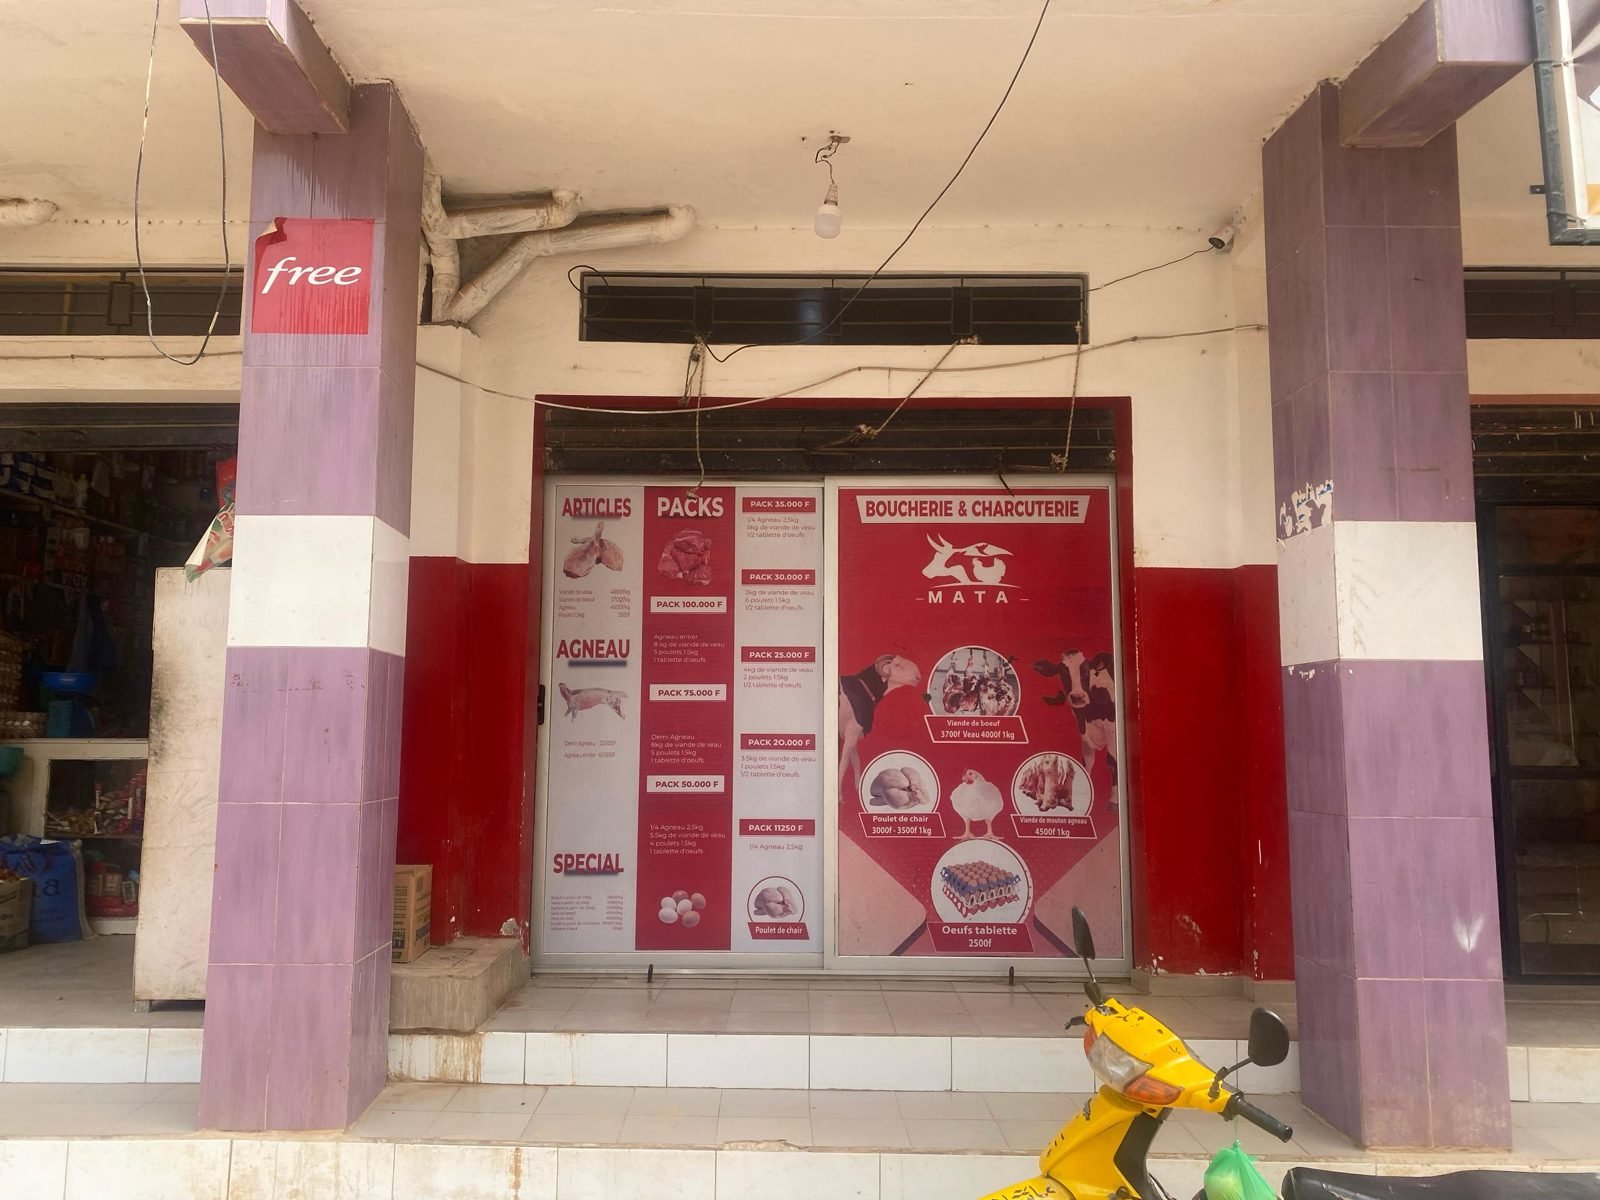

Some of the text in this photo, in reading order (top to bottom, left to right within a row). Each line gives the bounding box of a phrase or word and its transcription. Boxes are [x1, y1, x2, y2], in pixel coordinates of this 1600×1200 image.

[261, 255, 363, 295] free
[561, 497, 632, 518] ARTICLES
[656, 496, 725, 518] PACKS
[750, 500, 810, 508] PACK 35.000 F
[865, 500, 1080, 518] BOUCHERIE & CHARCUTERIE
[749, 573, 811, 581] PACK 30.000 F
[927, 590, 1009, 604] MATA
[555, 638, 631, 659] AGNEAU
[749, 651, 810, 659] PACK 25.000 F
[658, 689, 721, 697] PACK 75.000 F
[946, 719, 1001, 727] Viande de boeuf
[669, 734, 695, 742] Agneau
[940, 730, 1015, 741] 3700f Veau 4000f 1kg
[805, 739, 811, 747] F
[872, 815, 929, 823] Poulet de chair
[1020, 816, 1038, 824] Viande
[1067, 818, 1088, 826] agneau
[748, 824, 804, 832] PACK 11250 F
[871, 826, 932, 836] 3000f 3500f 1kg
[1034, 828, 1070, 838] 4500f 1kg
[552, 852, 625, 874] SPECIAL
[755, 926, 803, 934] Poulet de chair
[941, 925, 1018, 935] Oeufs tablette
[968, 938, 993, 948] 2500f
